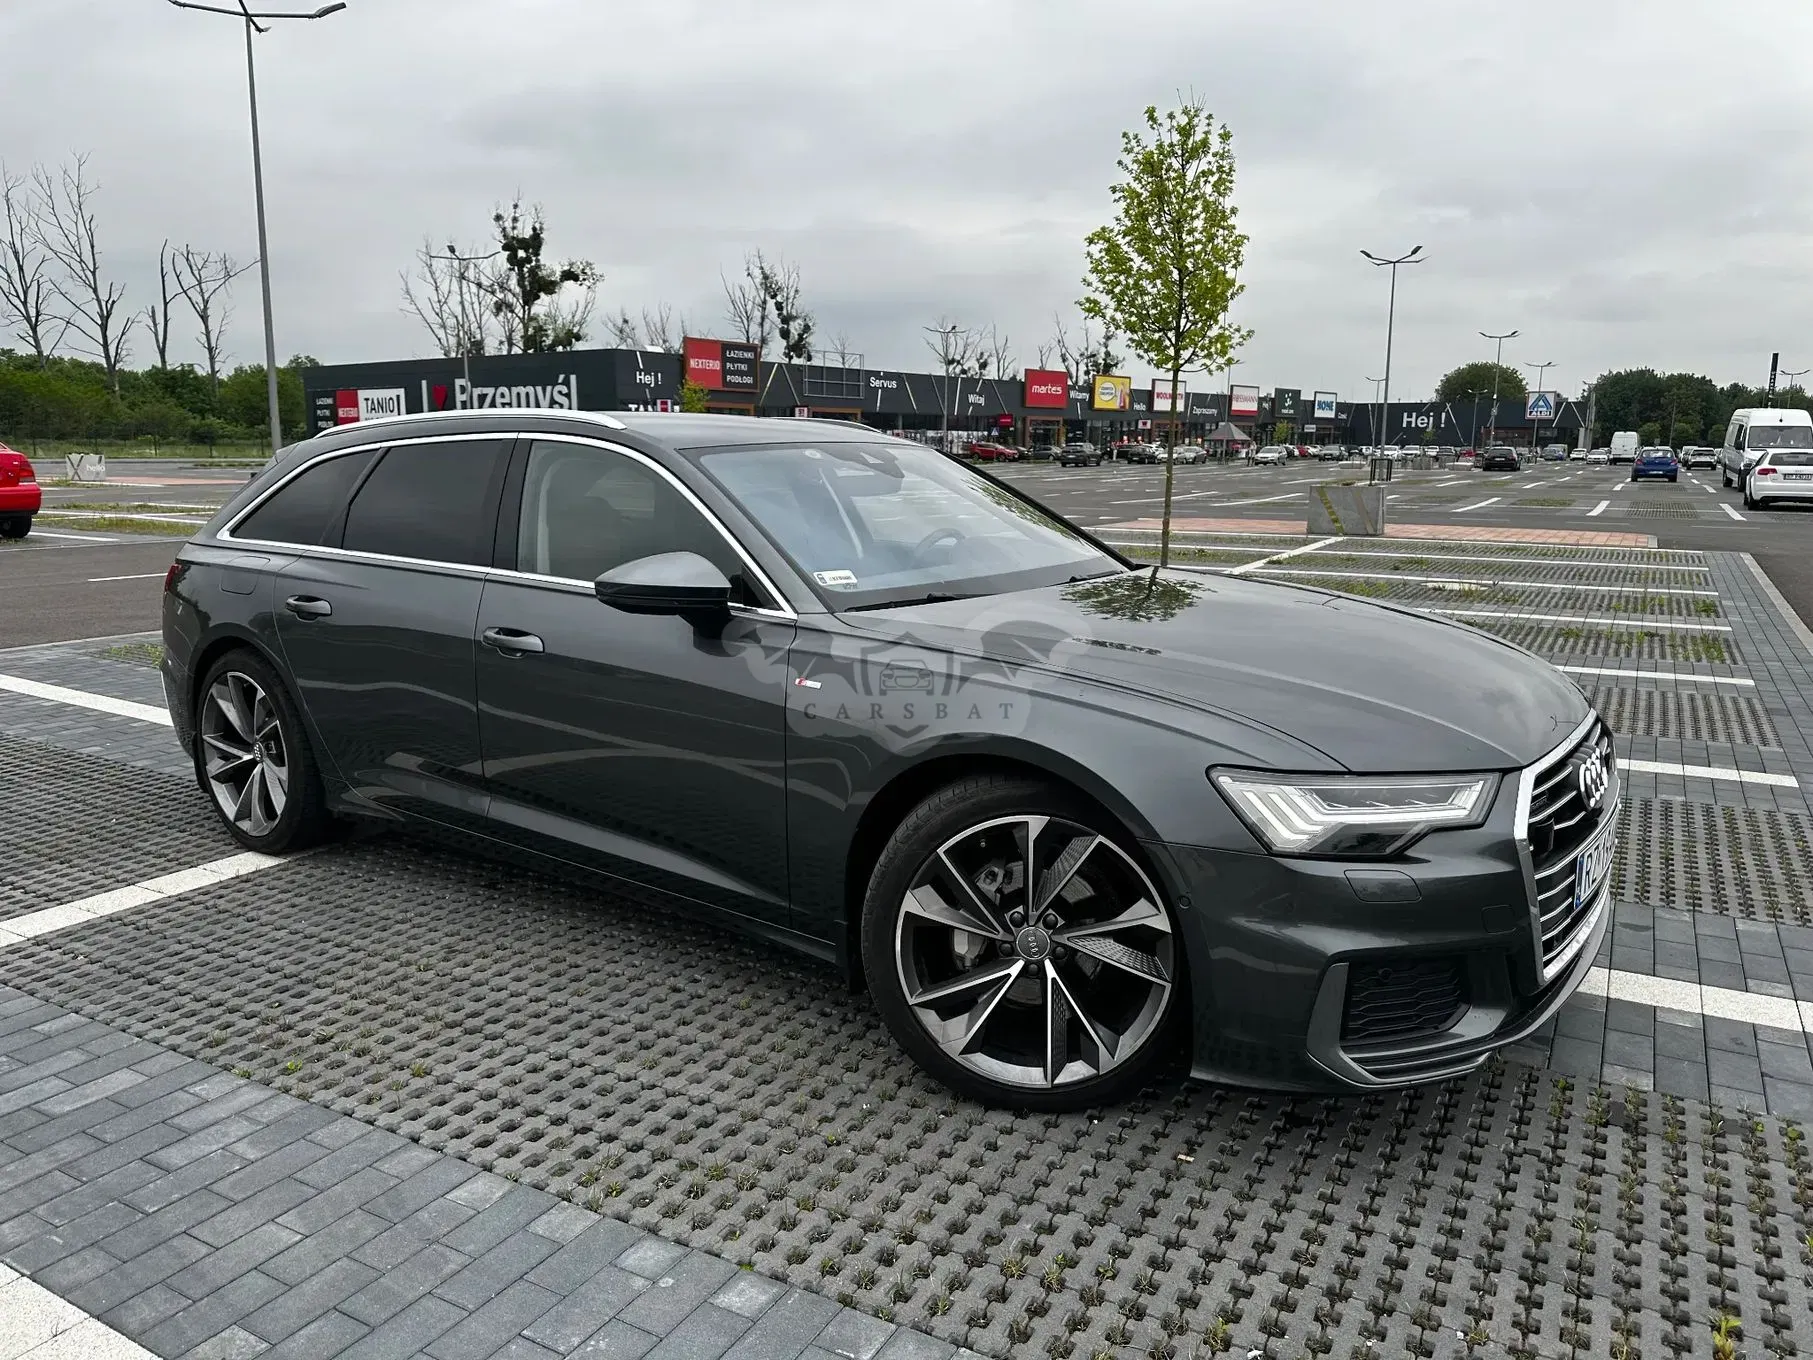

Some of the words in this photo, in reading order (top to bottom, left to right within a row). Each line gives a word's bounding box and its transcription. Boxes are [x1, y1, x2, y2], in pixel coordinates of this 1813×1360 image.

[726, 350, 754, 359] ŁAZIENKI
[689, 359, 720, 370] NEXTERIO
[726, 362, 747, 371] PŁYTKI
[636, 371, 655, 387] Hej
[726, 375, 753, 384] PODŁOGI
[869, 376, 897, 388] Servus
[421, 380, 429, 412] I
[454, 374, 578, 410] Przemyśl
[1031, 383, 1062, 394] martes
[968, 394, 985, 406] Witaj
[1069, 390, 1090, 401] Witamy
[1133, 402, 1146, 411] Hello
[1402, 412, 1434, 431] Hej
